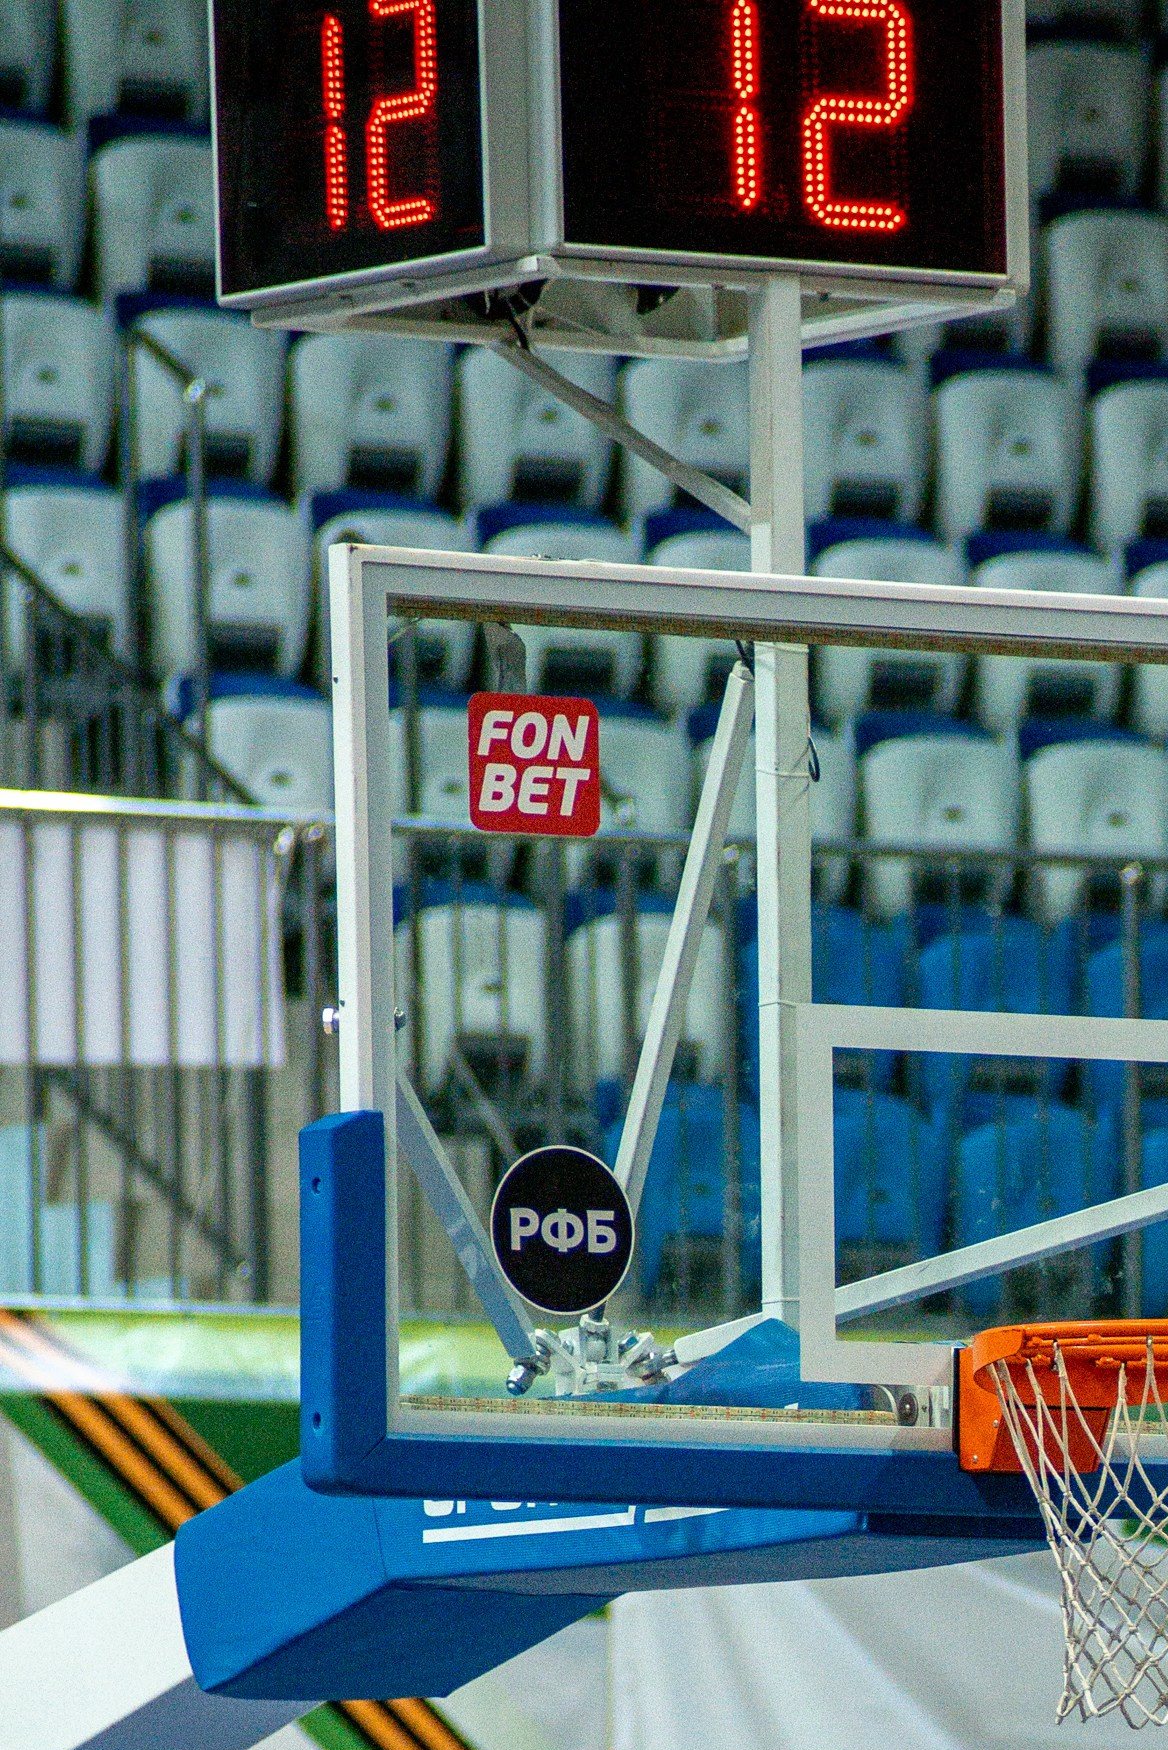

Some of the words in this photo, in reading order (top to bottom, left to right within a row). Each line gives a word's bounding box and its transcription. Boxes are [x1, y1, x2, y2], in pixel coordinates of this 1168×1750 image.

[322, 0, 436, 230] 12
[731, 0, 907, 229] 12
[477, 710, 590, 762] FON
[478, 762, 591, 817] BET
[509, 1207, 617, 1254] РФБ
